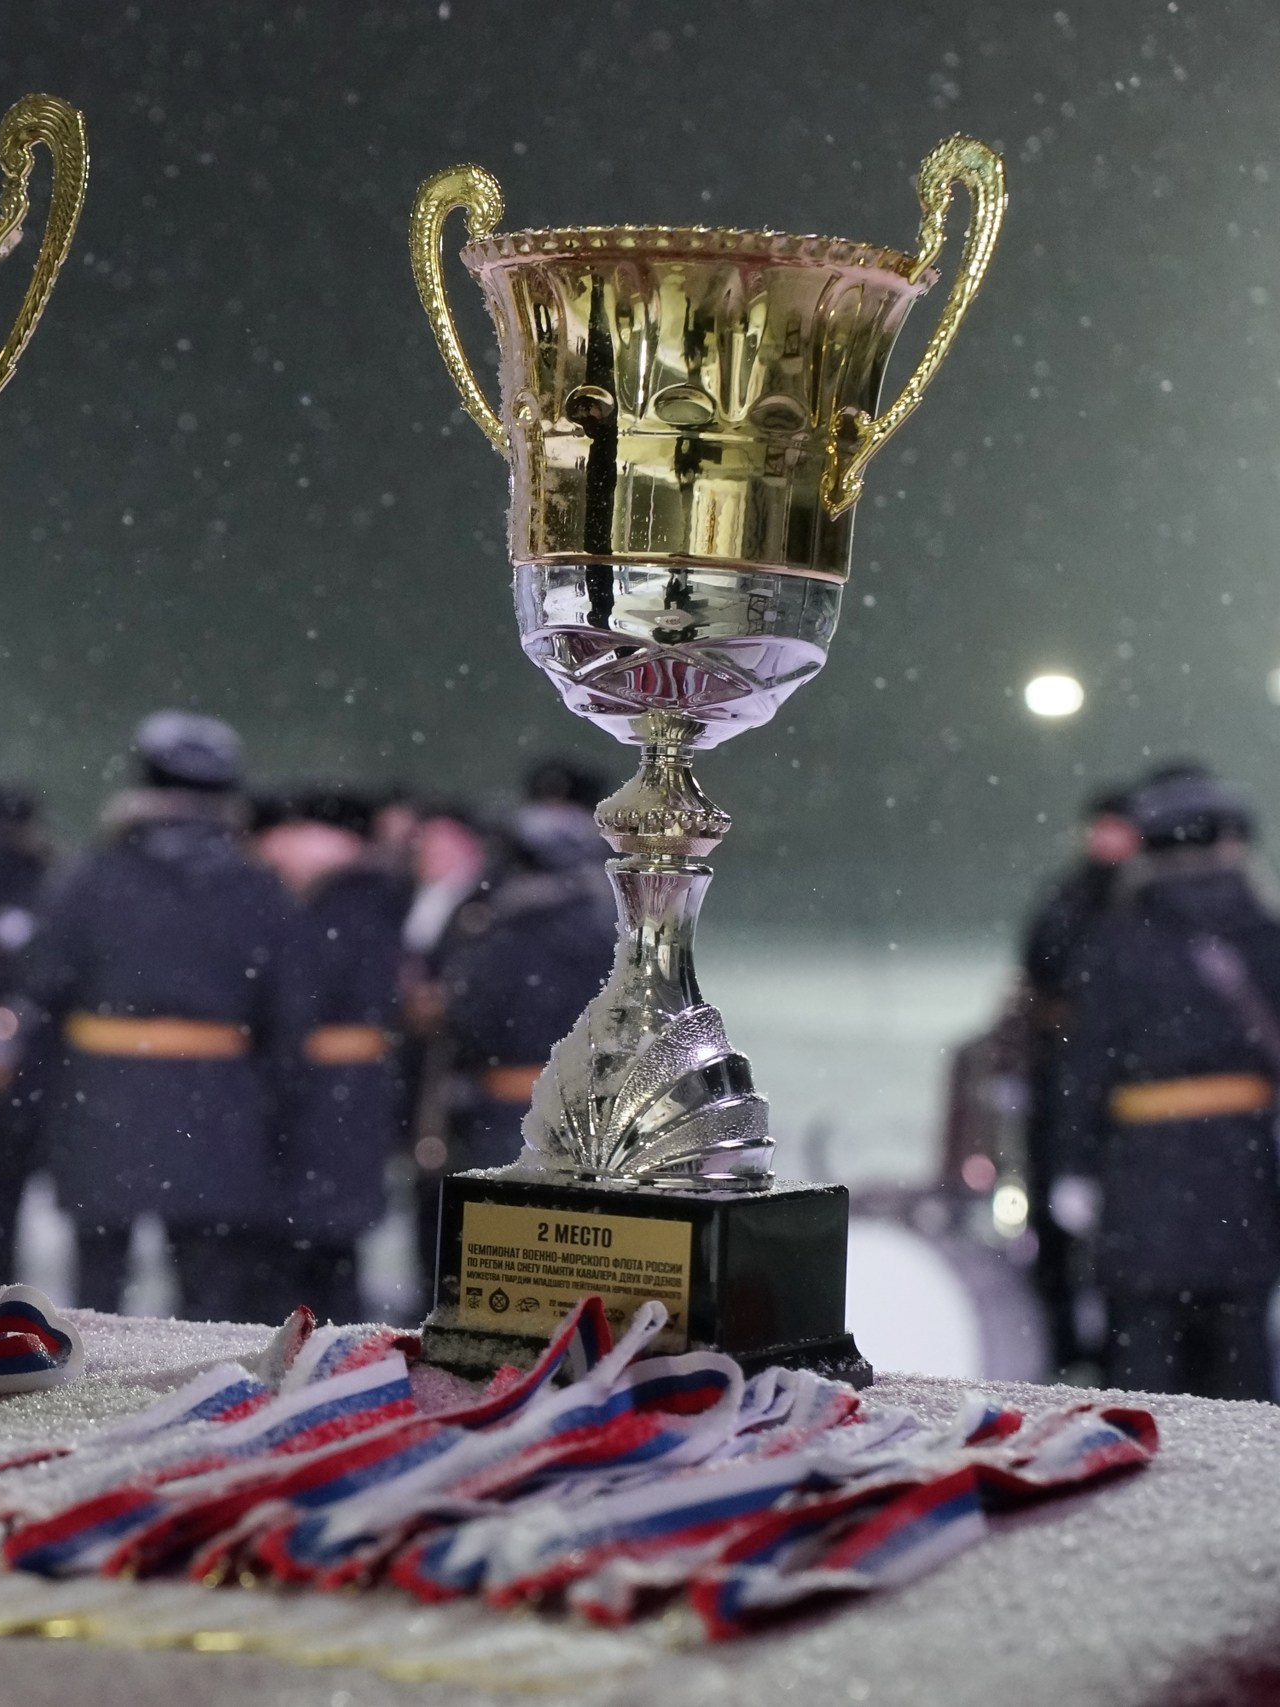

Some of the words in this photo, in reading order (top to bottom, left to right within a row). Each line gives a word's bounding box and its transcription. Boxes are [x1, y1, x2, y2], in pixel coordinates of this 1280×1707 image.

[537, 1222, 549, 1242] 2
[554, 1223, 612, 1248] МЕСТО
[467, 1243, 520, 1259] ЧЕМПИОНАТ
[522, 1248, 610, 1268] ВОЕННО-МОРСКОГО
[612, 1257, 643, 1271] ФЛОТА
[645, 1260, 683, 1274] РОССИИ
[467, 1256, 478, 1267] ПО
[479, 1258, 503, 1269] РЕГБИ
[504, 1260, 516, 1271] НА
[516, 1261, 540, 1273] СНЕГУ
[542, 1264, 574, 1277] ПАМЯТИ
[575, 1267, 617, 1281] КАВАЛЕРА
[618, 1272, 641, 1284] ДВУХ
[642, 1274, 682, 1288] ОРДЕНОВ
